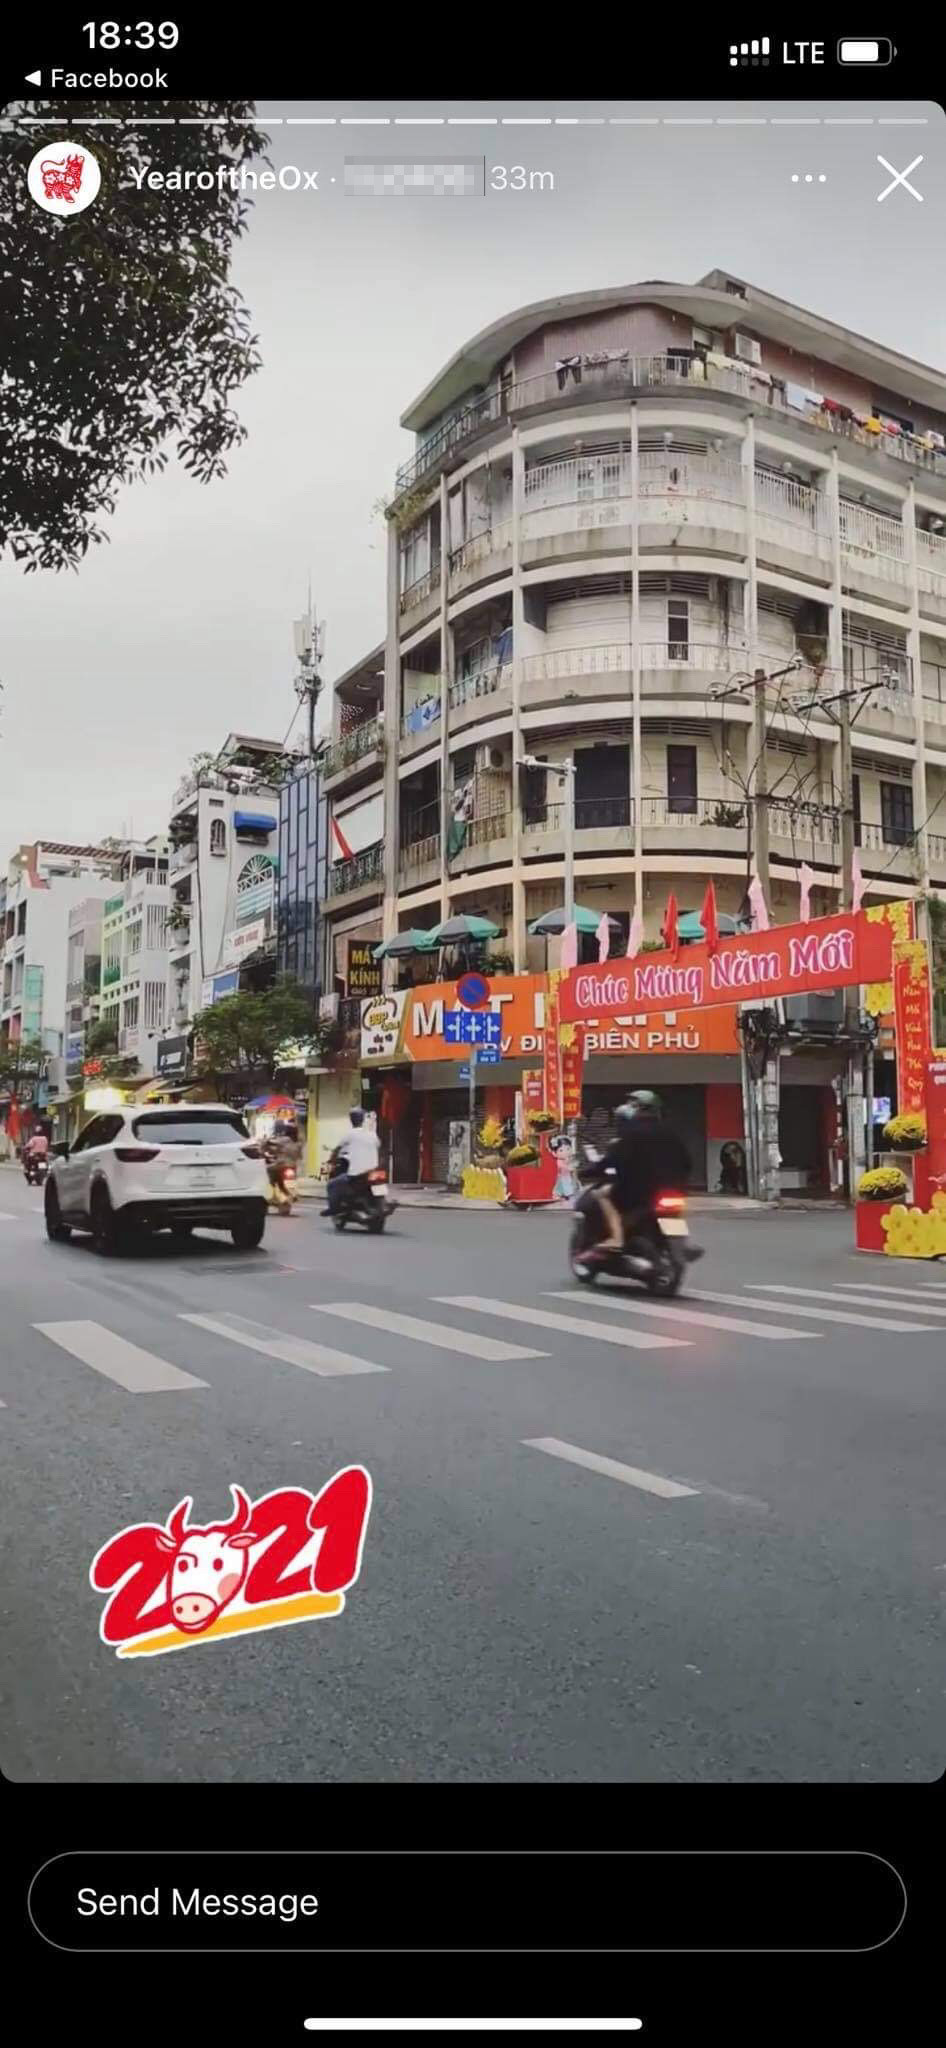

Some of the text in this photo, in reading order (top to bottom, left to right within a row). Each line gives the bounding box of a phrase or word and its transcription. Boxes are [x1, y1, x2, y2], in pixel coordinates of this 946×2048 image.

[350, 967, 380, 985] KÍNH
[576, 930, 854, 1008] Chúc Mừng Năm Mới
[584, 1027, 640, 1050] BIÊN
[647, 1025, 700, 1049] PHỦ
